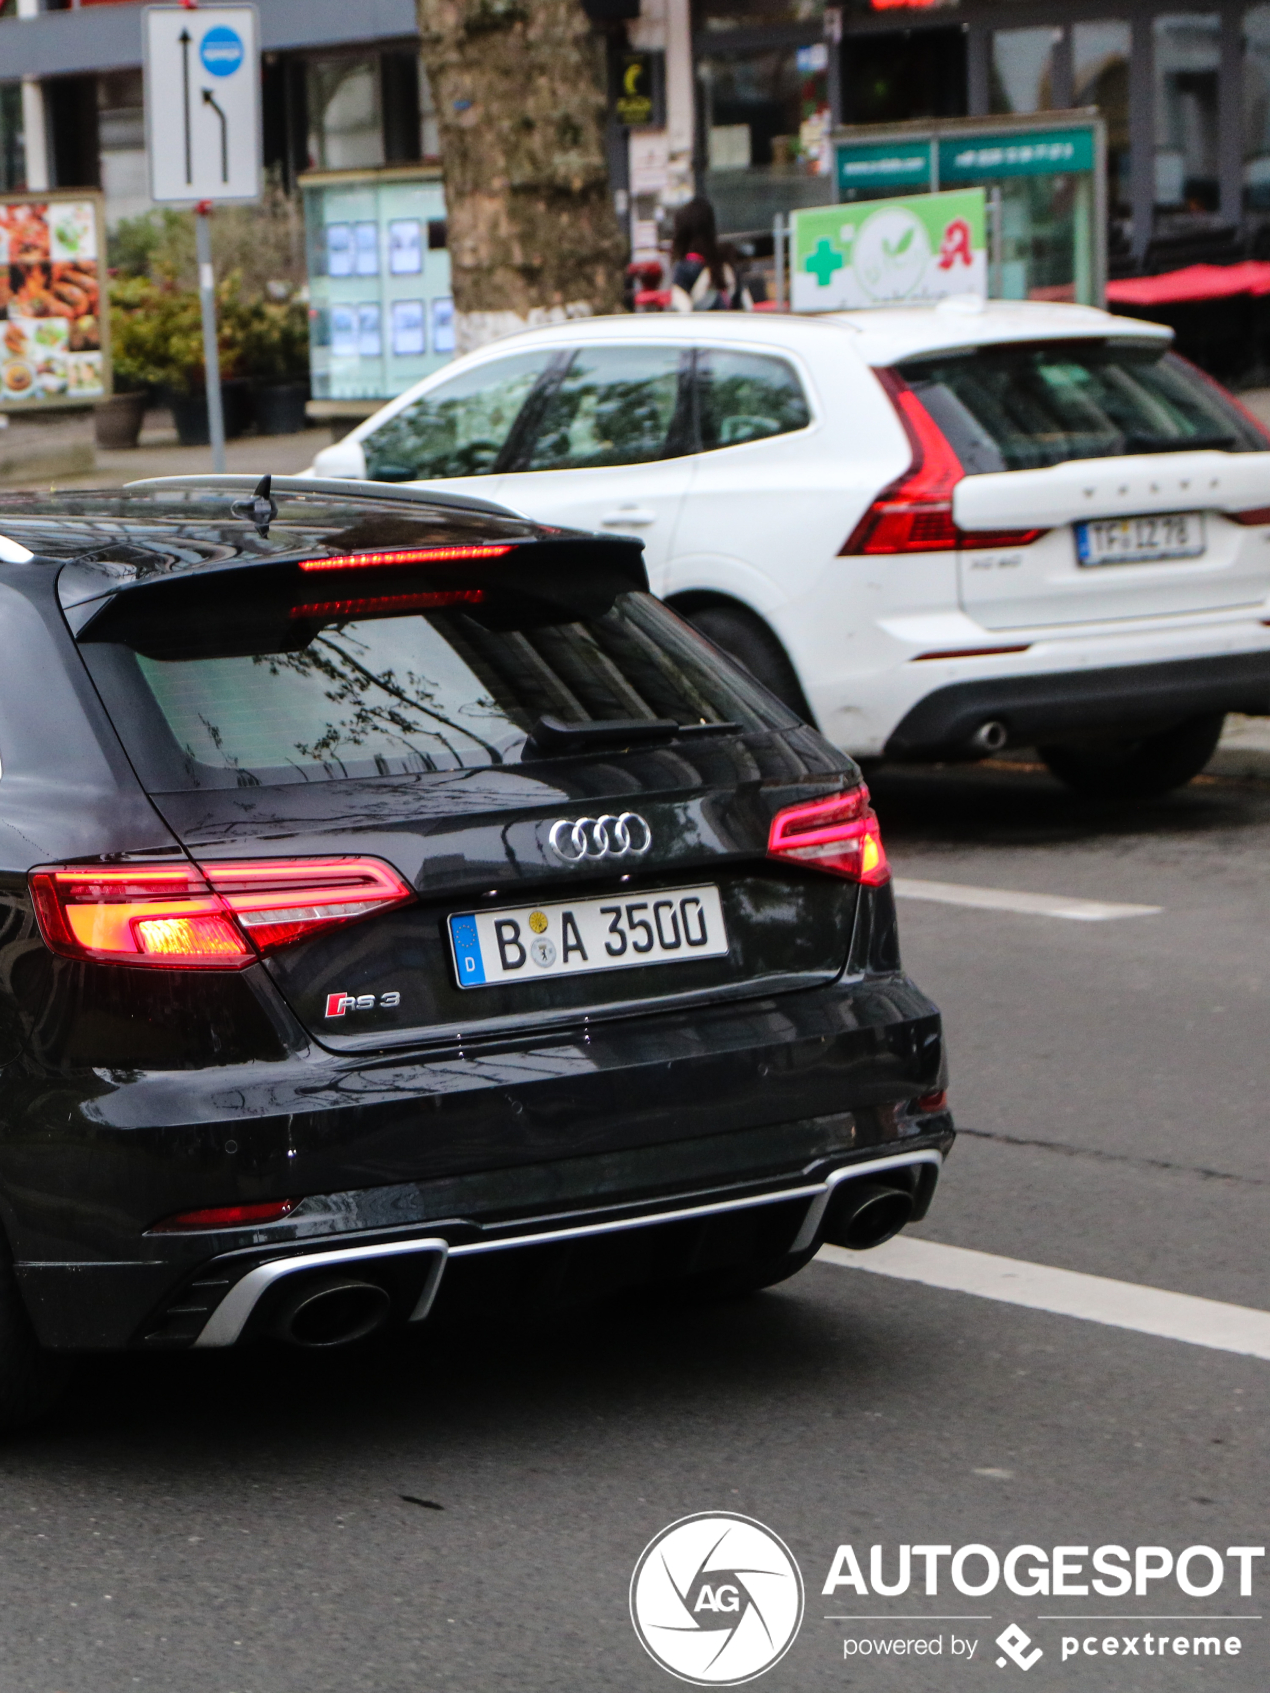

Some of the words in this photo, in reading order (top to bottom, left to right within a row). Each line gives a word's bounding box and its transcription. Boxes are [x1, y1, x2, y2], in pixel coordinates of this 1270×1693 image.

[494, 919, 526, 971] B
[561, 911, 588, 963] A
[599, 897, 709, 957] 3500
[465, 956, 476, 972] D
[336, 994, 376, 1013] RS
[379, 991, 401, 1008] 3
